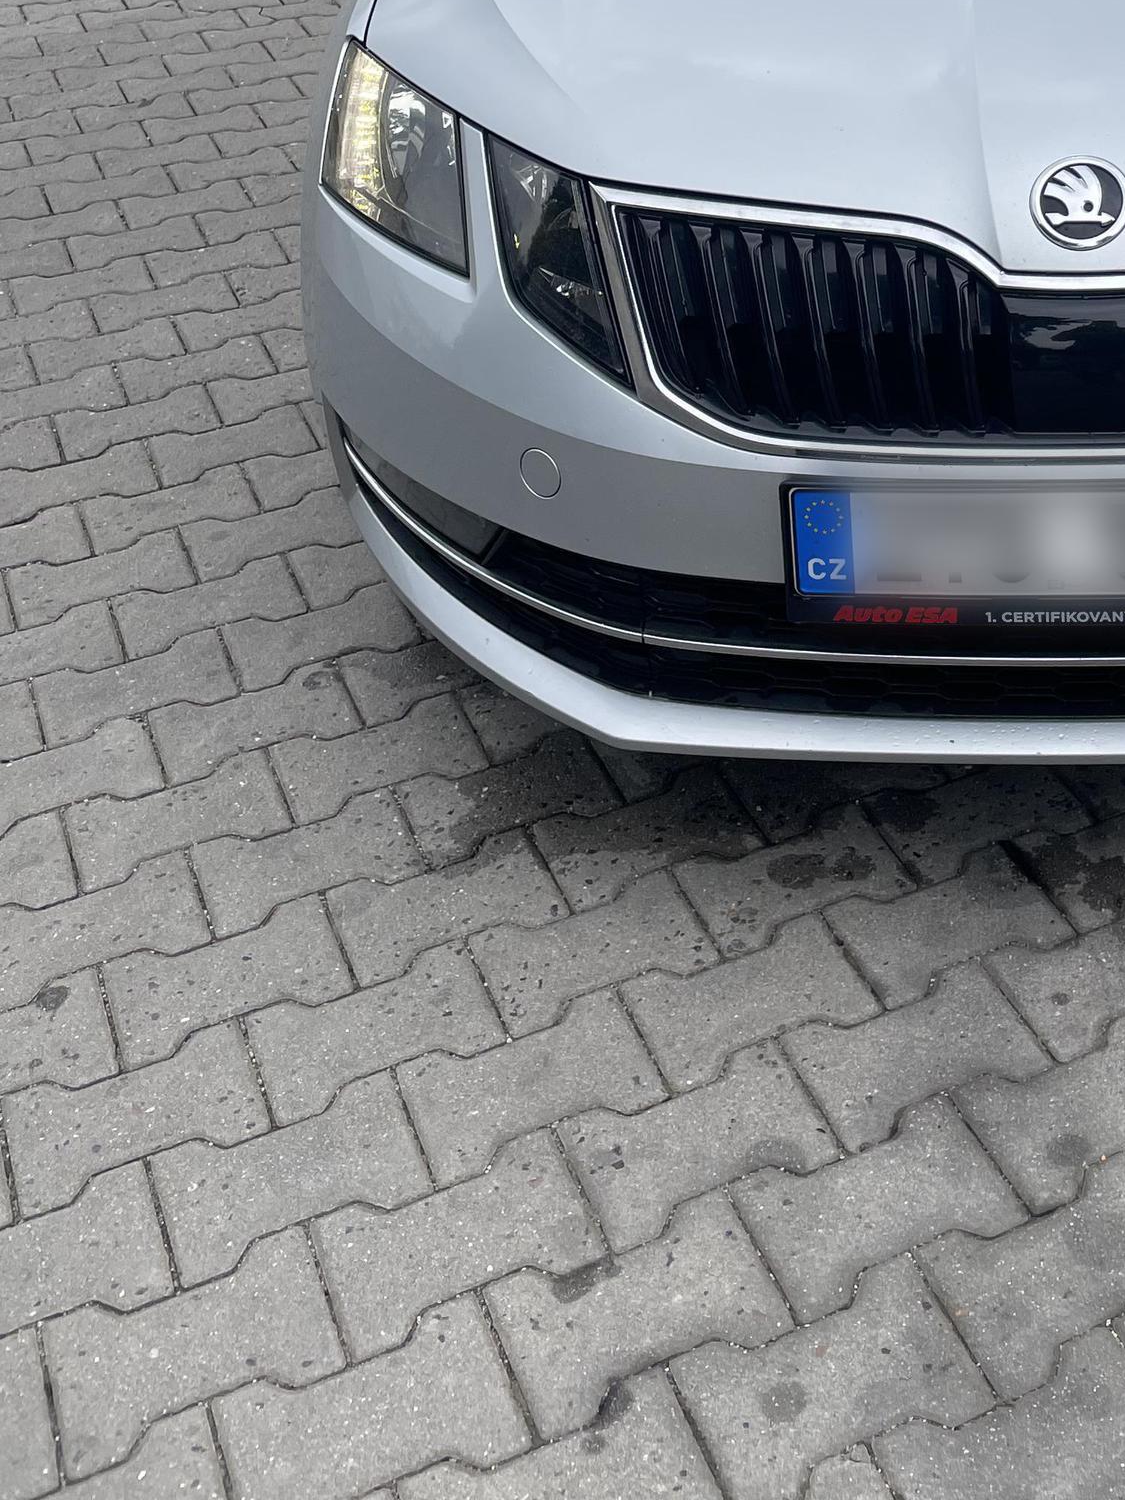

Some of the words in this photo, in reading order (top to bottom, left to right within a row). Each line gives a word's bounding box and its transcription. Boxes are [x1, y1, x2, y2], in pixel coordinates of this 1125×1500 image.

[807, 557, 847, 581] CZ
[833, 605, 903, 622] Auto
[905, 607, 958, 623] ESA
[985, 612, 996, 623] 1.
